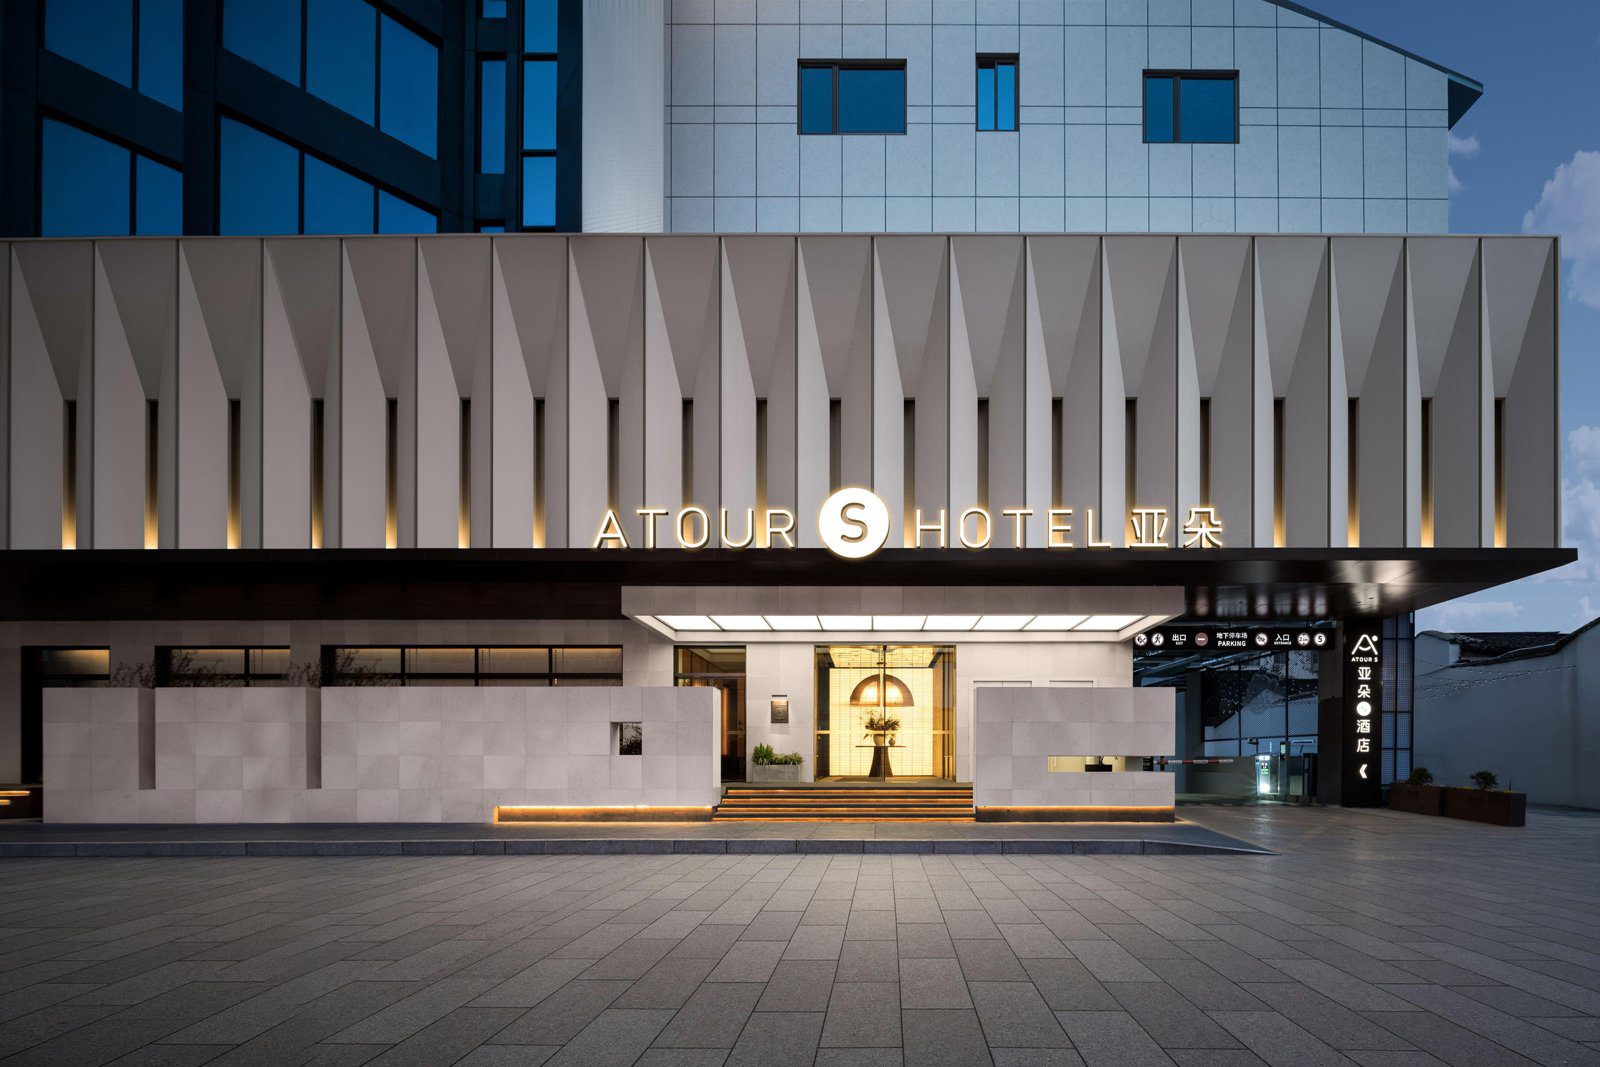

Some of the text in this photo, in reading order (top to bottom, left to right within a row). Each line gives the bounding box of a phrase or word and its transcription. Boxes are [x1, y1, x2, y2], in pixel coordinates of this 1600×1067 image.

[593, 502, 1223, 549] ATOUR S HOTEL 亚朵
[1171, 633, 1187, 642] 出口
[1275, 633, 1290, 642] 入口
[1317, 635, 1323, 643] 5
